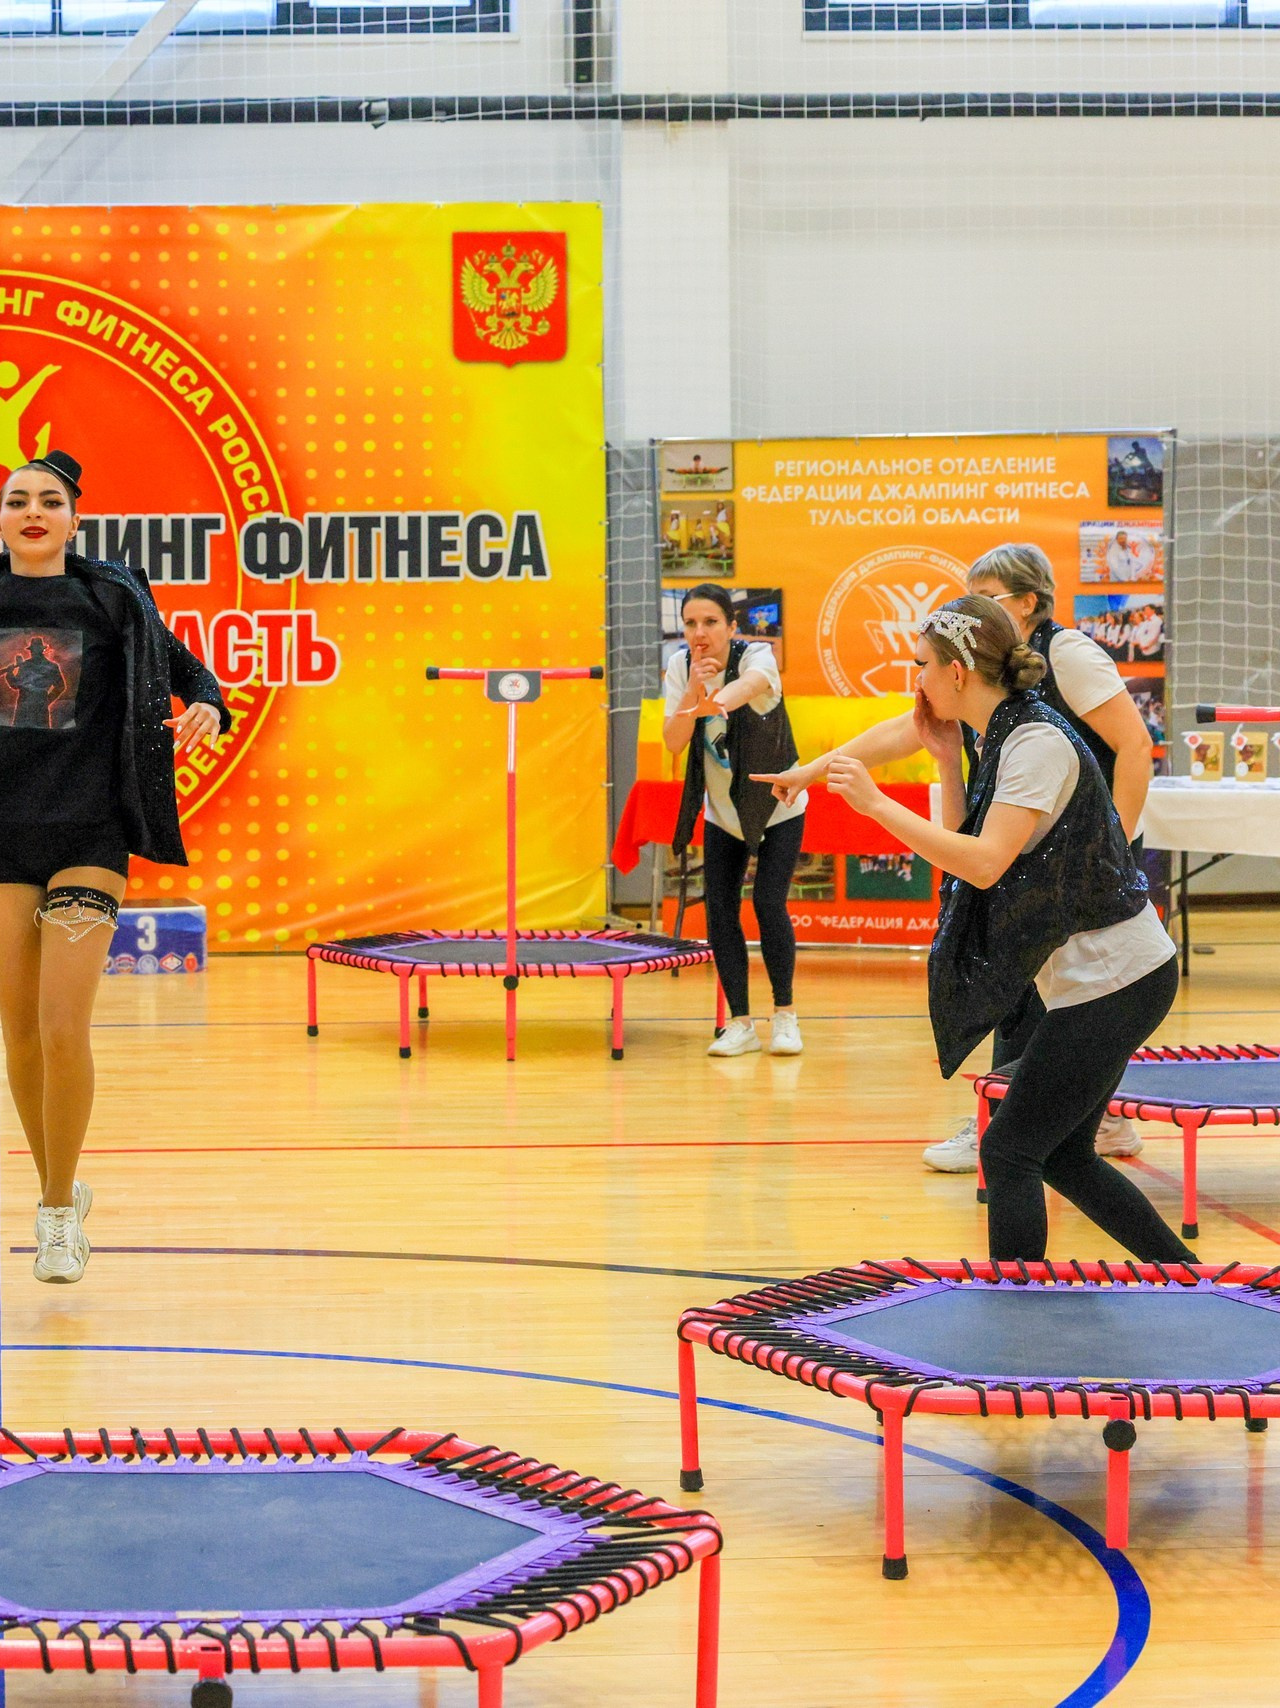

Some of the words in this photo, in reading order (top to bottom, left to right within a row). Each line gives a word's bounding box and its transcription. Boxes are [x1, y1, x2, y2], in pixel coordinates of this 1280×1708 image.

[56, 300, 214, 416] ФИТНЕСА
[207, 413, 273, 521] РОСС
[774, 458, 932, 478] РЕГИОНАЛЬНОЕ
[938, 457, 1056, 476] ОТДЕЛЕНИЕ
[741, 483, 863, 504] ФЕДЕРАЦИИ
[867, 482, 988, 502] ДЖАМПИНГ
[994, 480, 1090, 499] ФИТНЕСА
[809, 504, 916, 526] ТУЛЬСКОЙ
[922, 507, 1020, 525] ОБЛАСТИ
[240, 510, 552, 586] ФИТНЕСА
[160, 607, 342, 688] АСТЬ
[137, 915, 157, 951] 3
